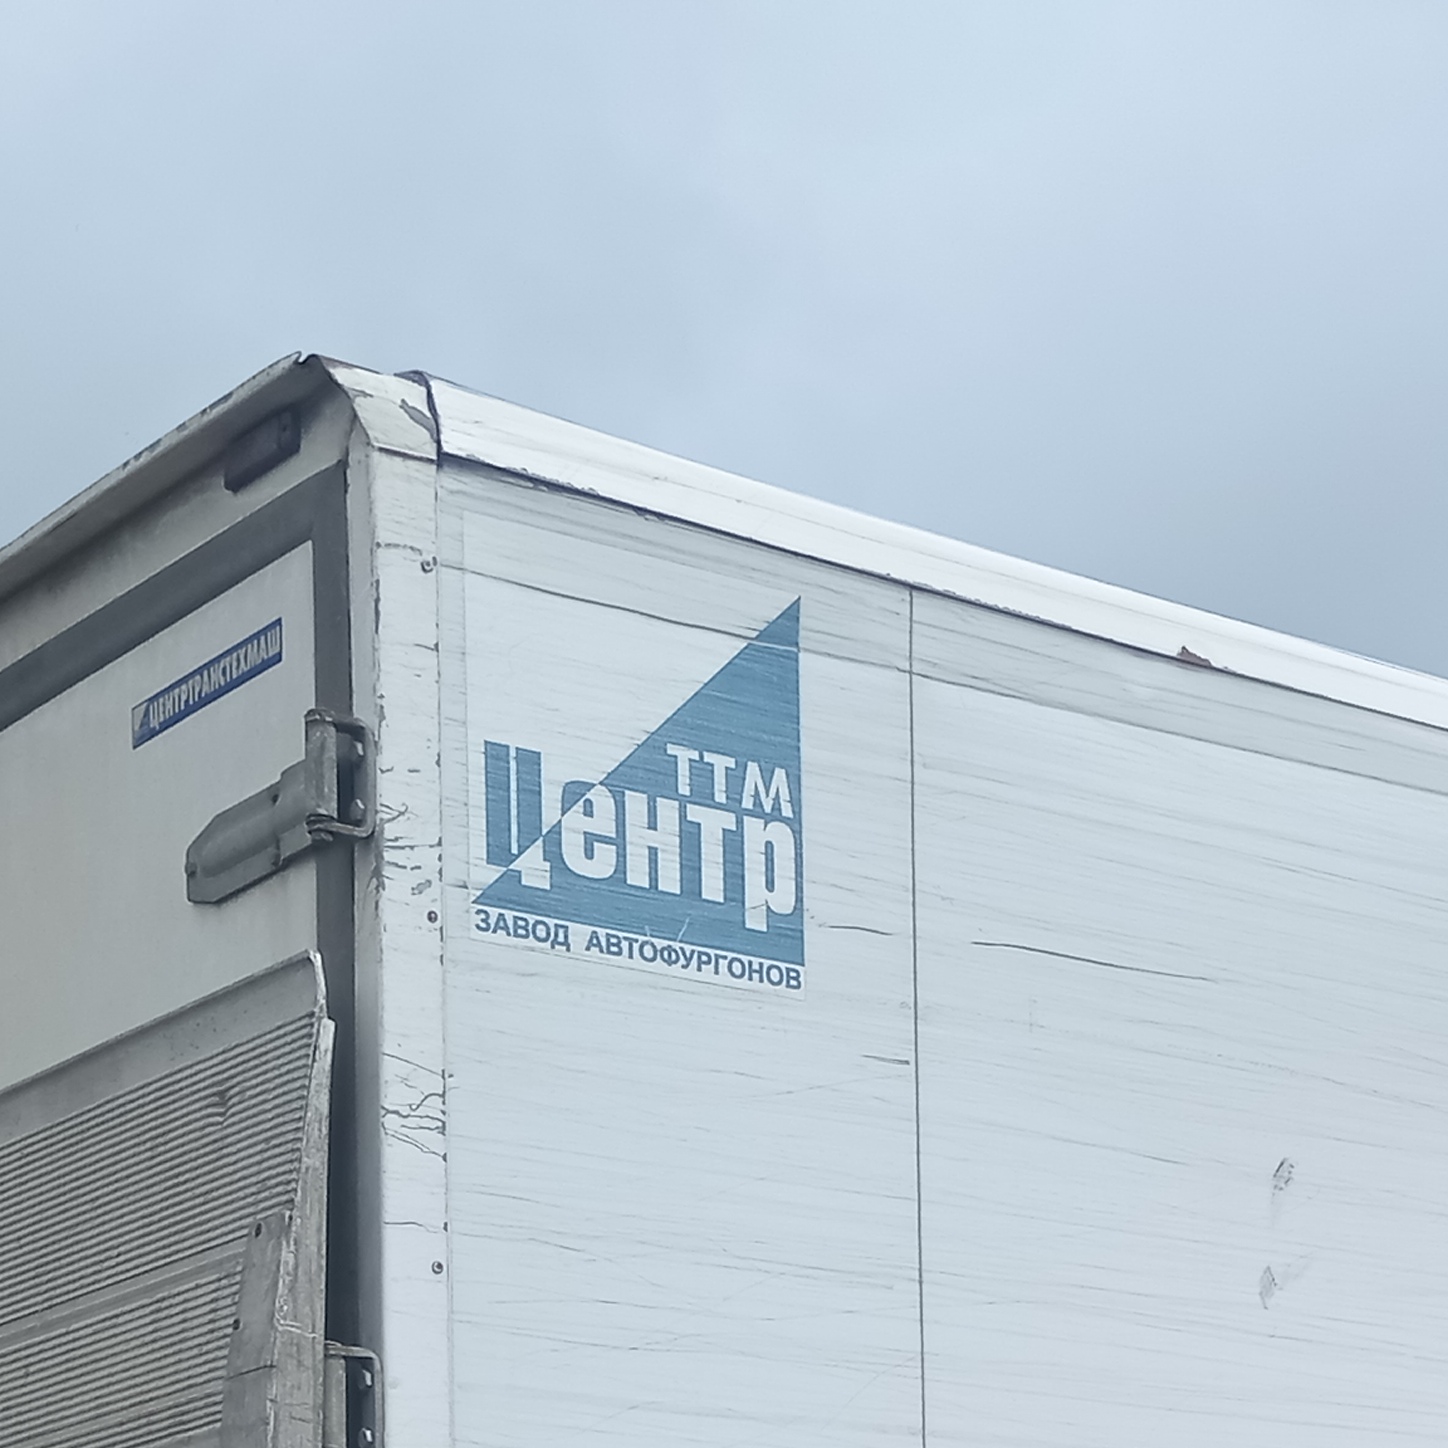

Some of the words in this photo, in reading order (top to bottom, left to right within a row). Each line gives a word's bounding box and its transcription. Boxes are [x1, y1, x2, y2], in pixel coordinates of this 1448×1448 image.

[149, 625, 281, 731] ЦЕНТРТРАНСТЕХМАШ
[666, 742, 794, 819] ТТМ
[484, 739, 797, 933] Центр
[473, 907, 571, 952] ЗАВОД
[584, 929, 803, 991] АВТОФУРГОНОВ
